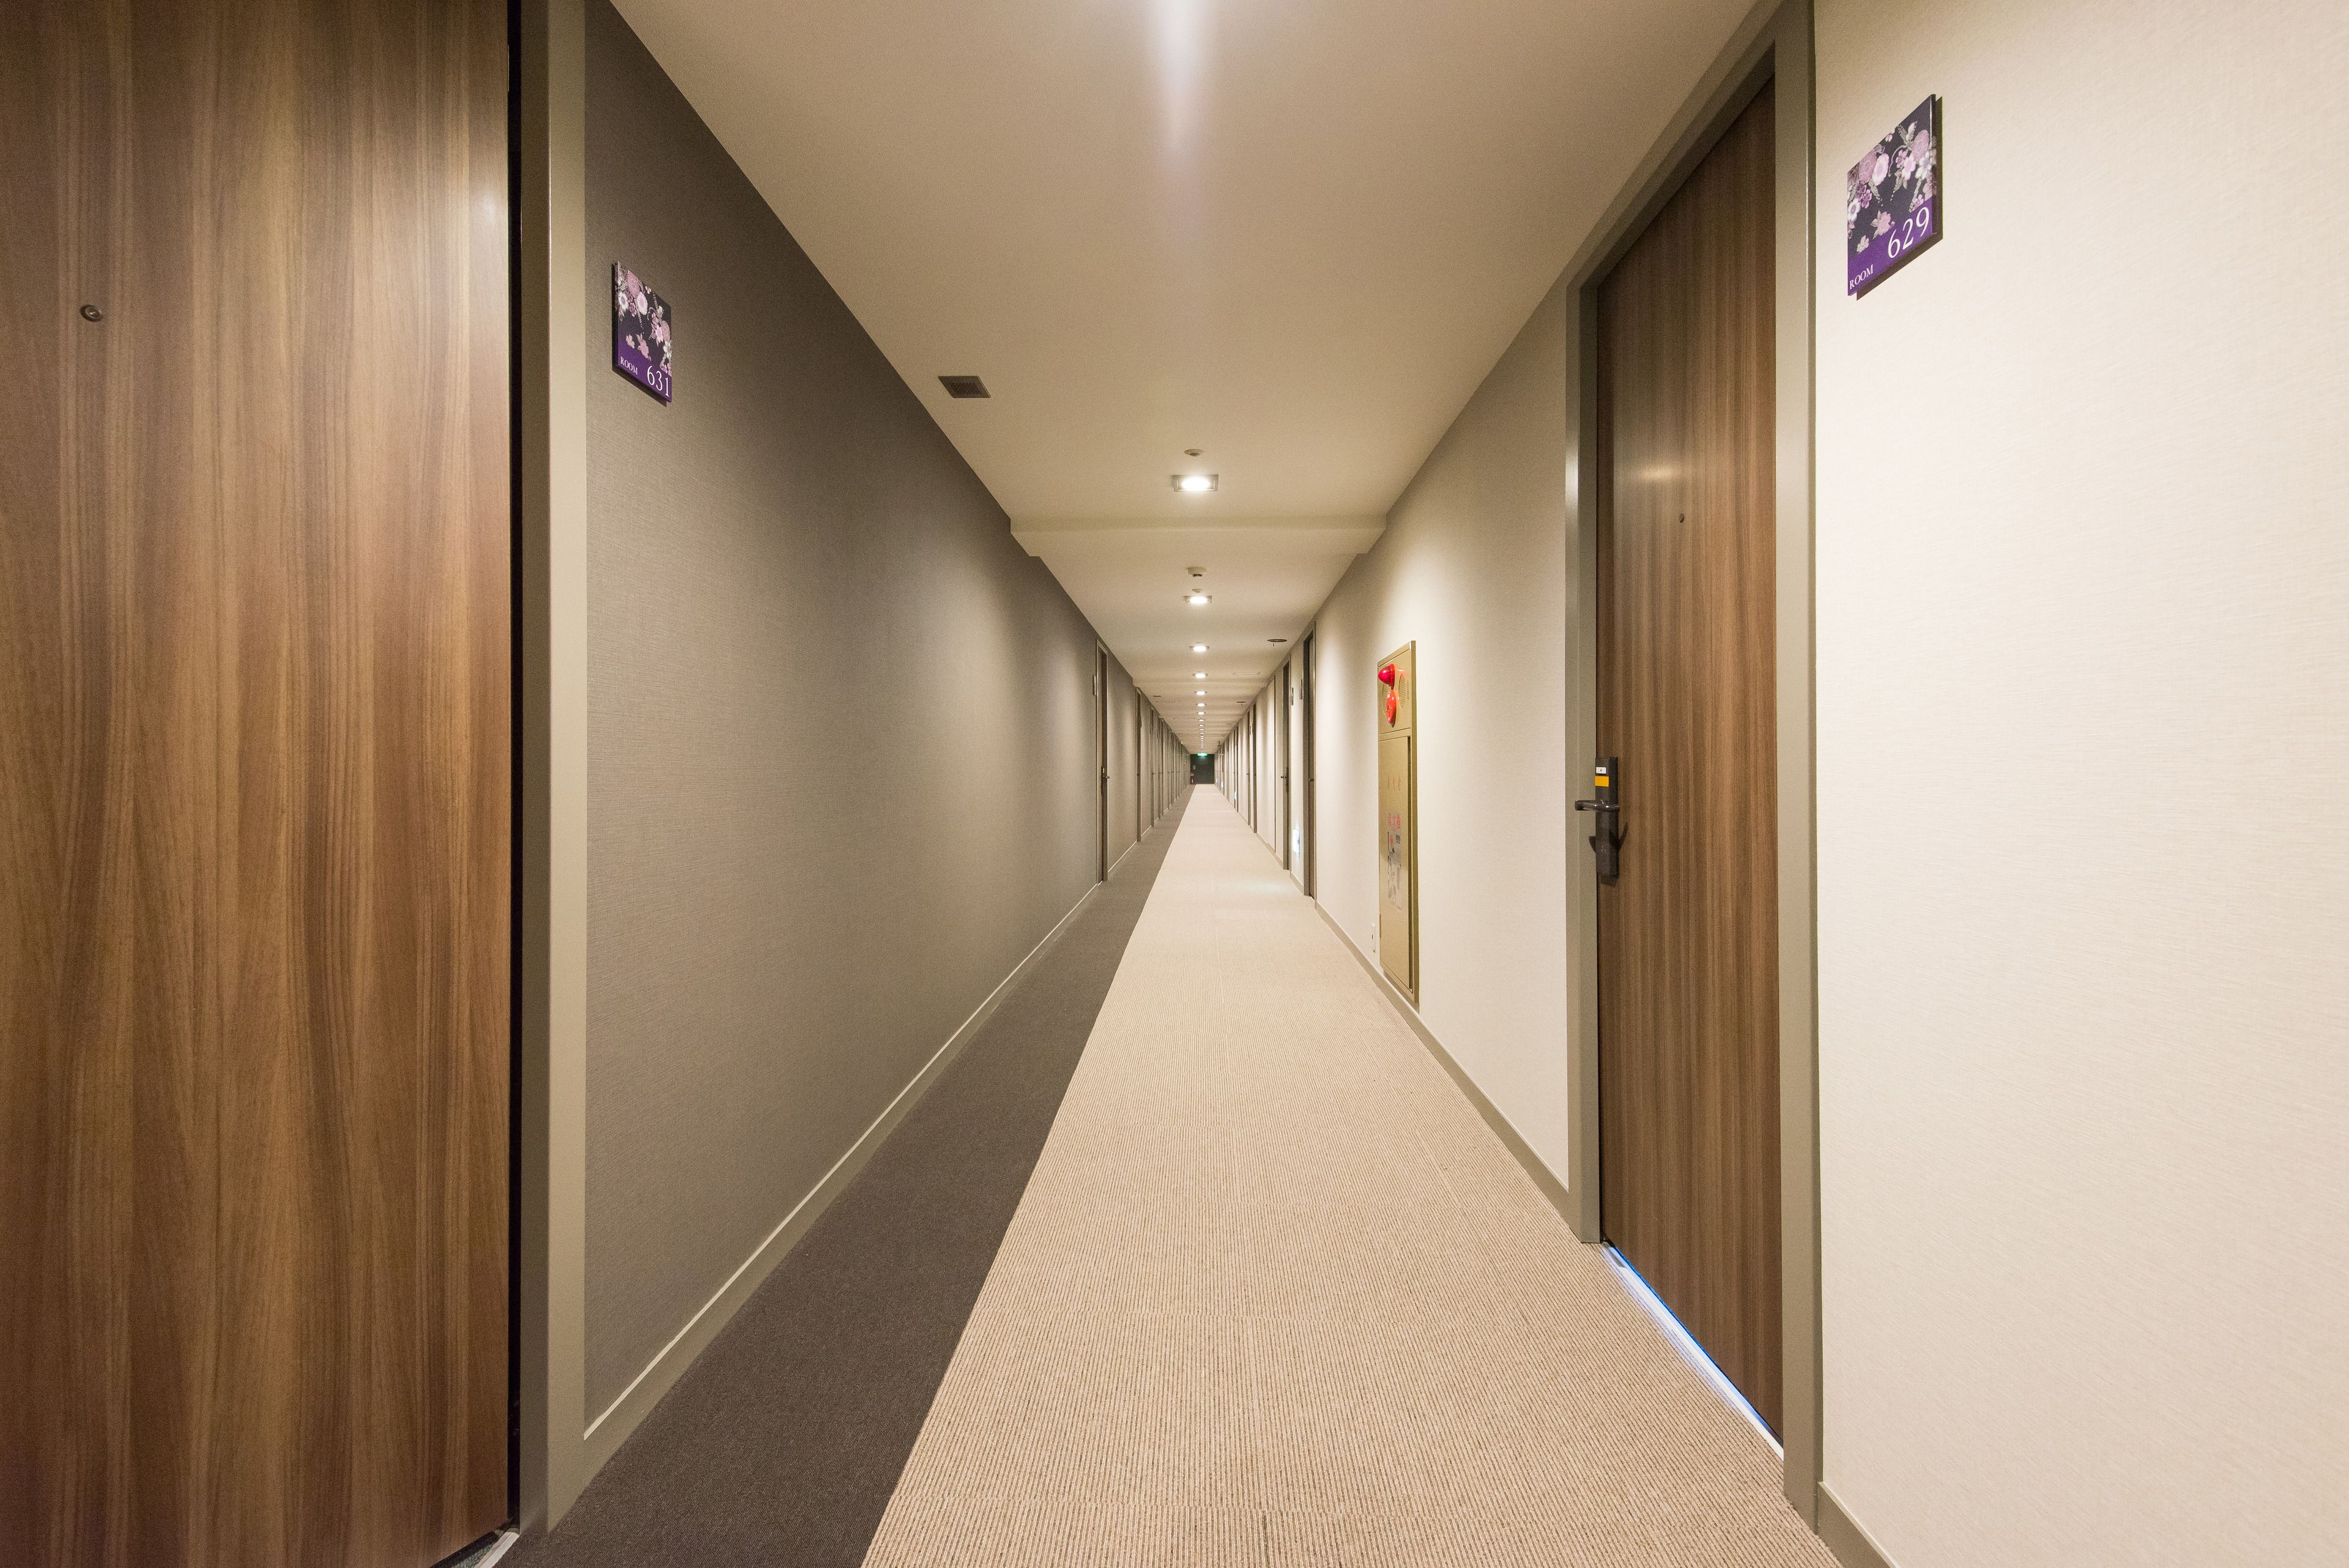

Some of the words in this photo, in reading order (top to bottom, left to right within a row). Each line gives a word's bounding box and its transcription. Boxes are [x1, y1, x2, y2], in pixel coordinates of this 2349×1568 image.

[1849, 264, 1874, 290] ROOM
[1888, 206, 1929, 258] 629
[620, 356, 638, 375] ROOM
[647, 365, 670, 397] 631
